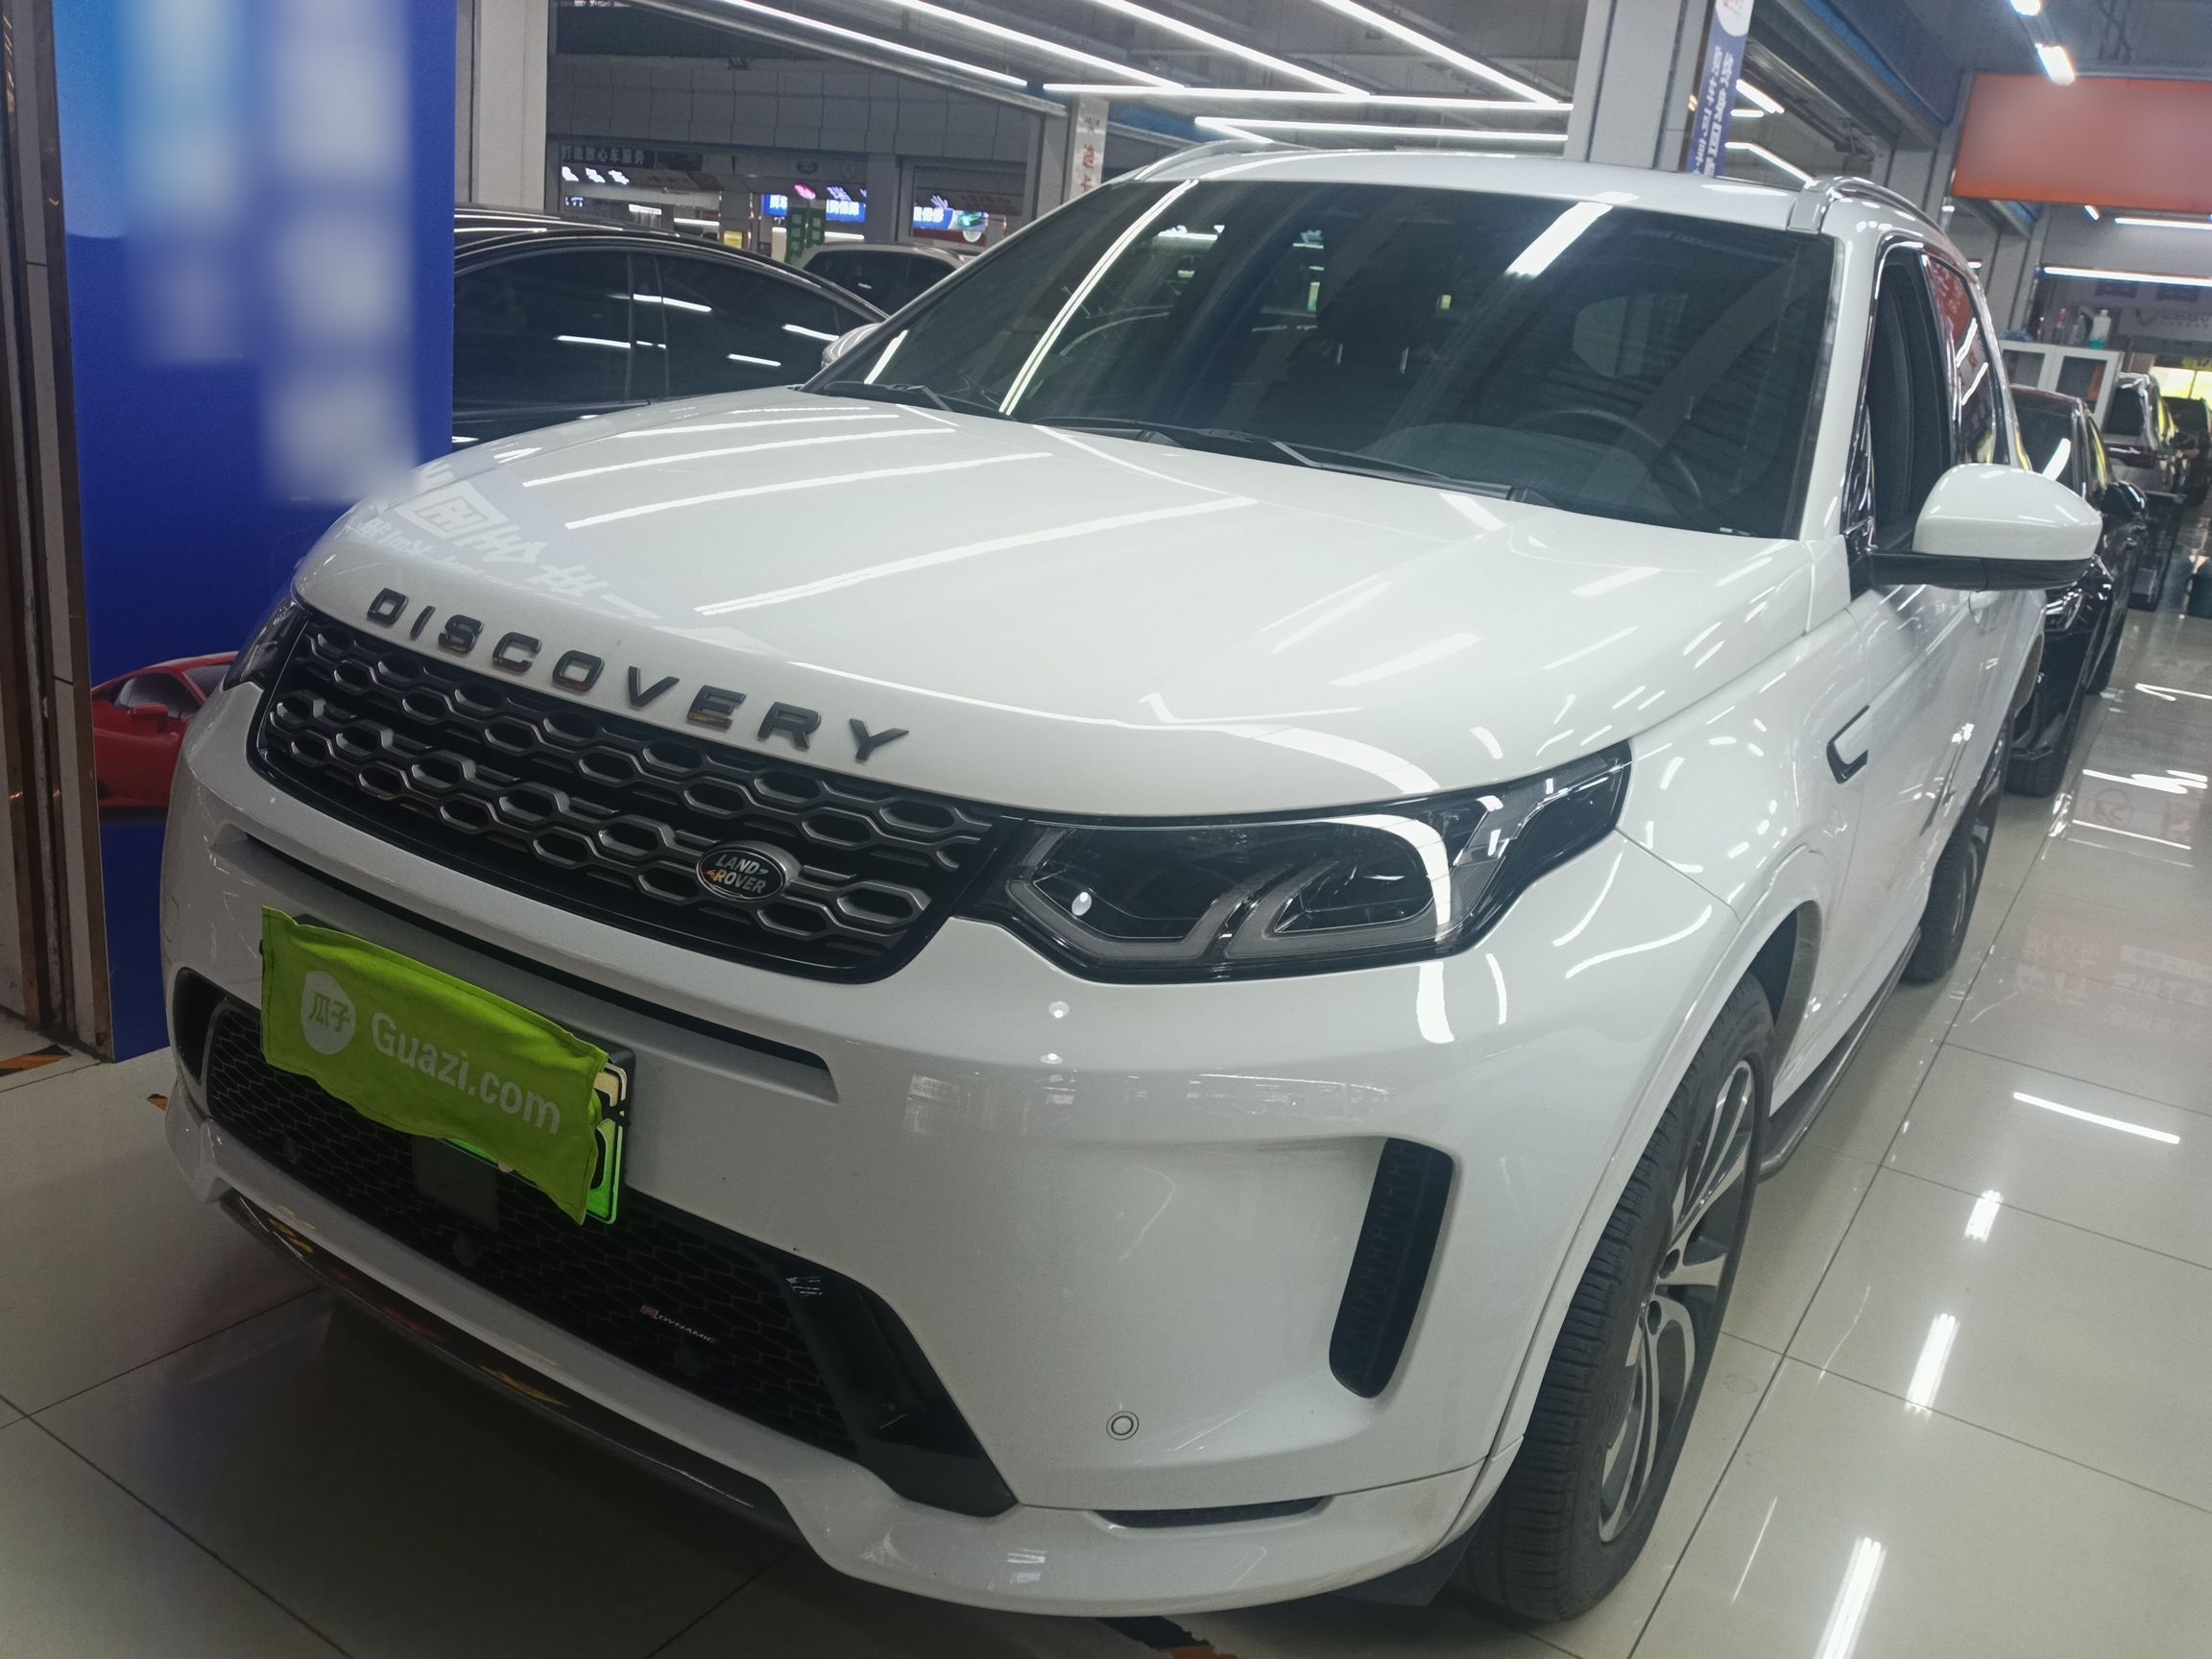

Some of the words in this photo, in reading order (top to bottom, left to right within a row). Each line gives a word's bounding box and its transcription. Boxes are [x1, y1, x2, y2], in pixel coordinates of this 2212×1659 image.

[367, 588, 909, 761] DISCOVERY
[712, 868, 767, 894] ROVER
[715, 854, 760, 875] LAND
[308, 991, 351, 1033] 瓜子
[371, 1011, 561, 1136] Guazi.com
